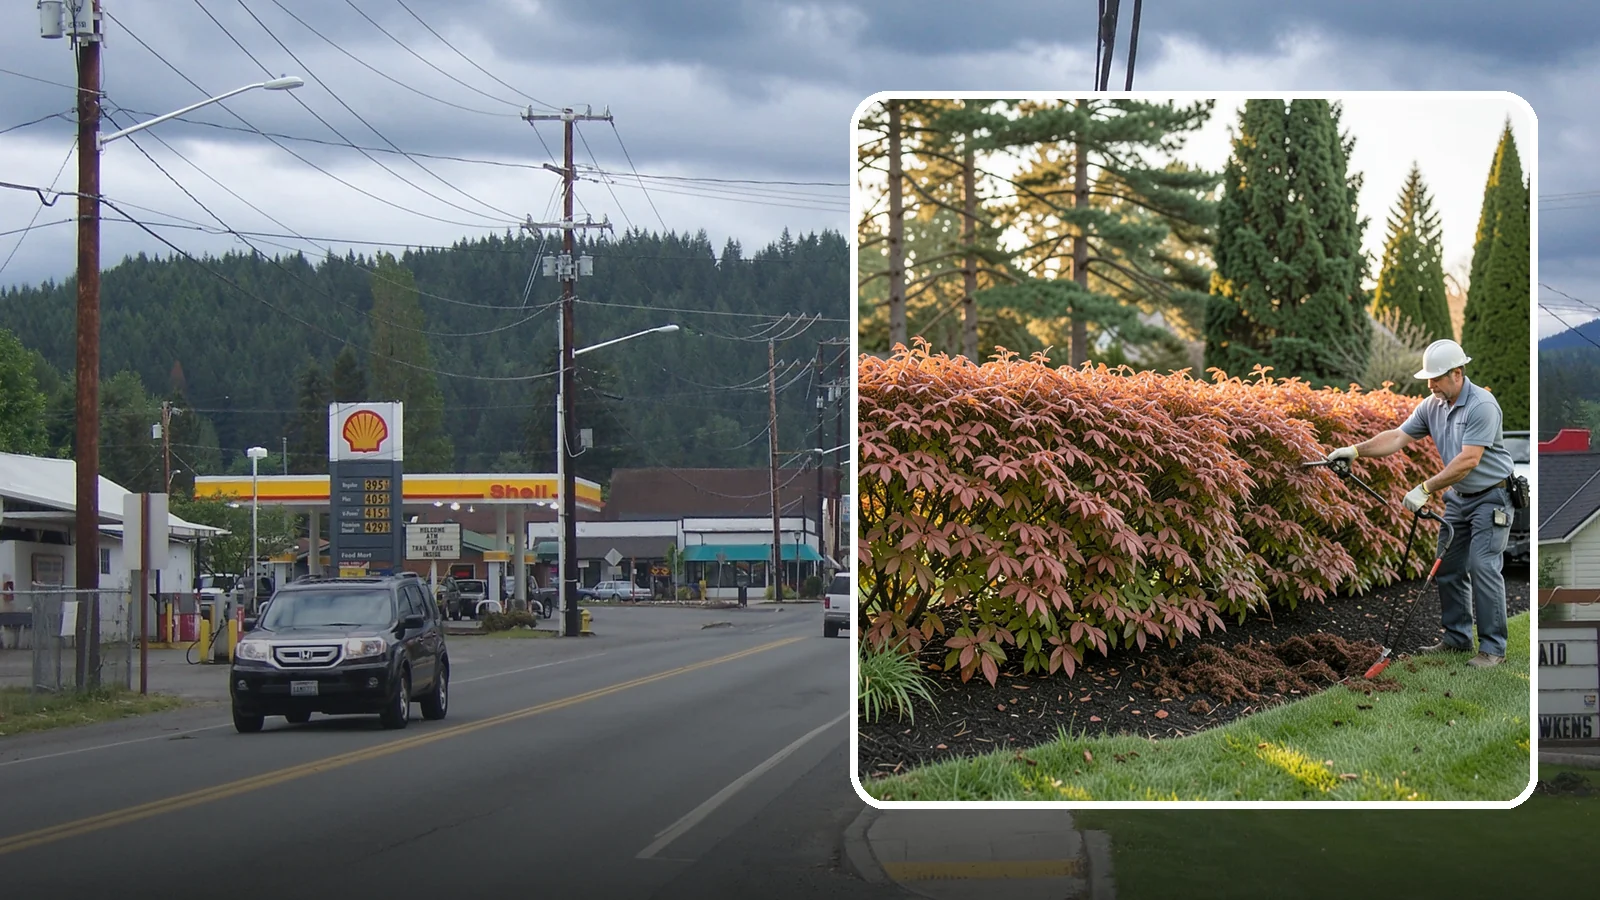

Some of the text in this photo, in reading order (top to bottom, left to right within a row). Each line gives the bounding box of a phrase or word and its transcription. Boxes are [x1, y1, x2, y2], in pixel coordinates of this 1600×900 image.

[365, 480, 383, 490] 395
[490, 484, 547, 499] Shell
[365, 494, 383, 504] 405
[365, 508, 383, 518] 415
[365, 522, 383, 532] 429
[1539, 643, 1566, 665] AID
